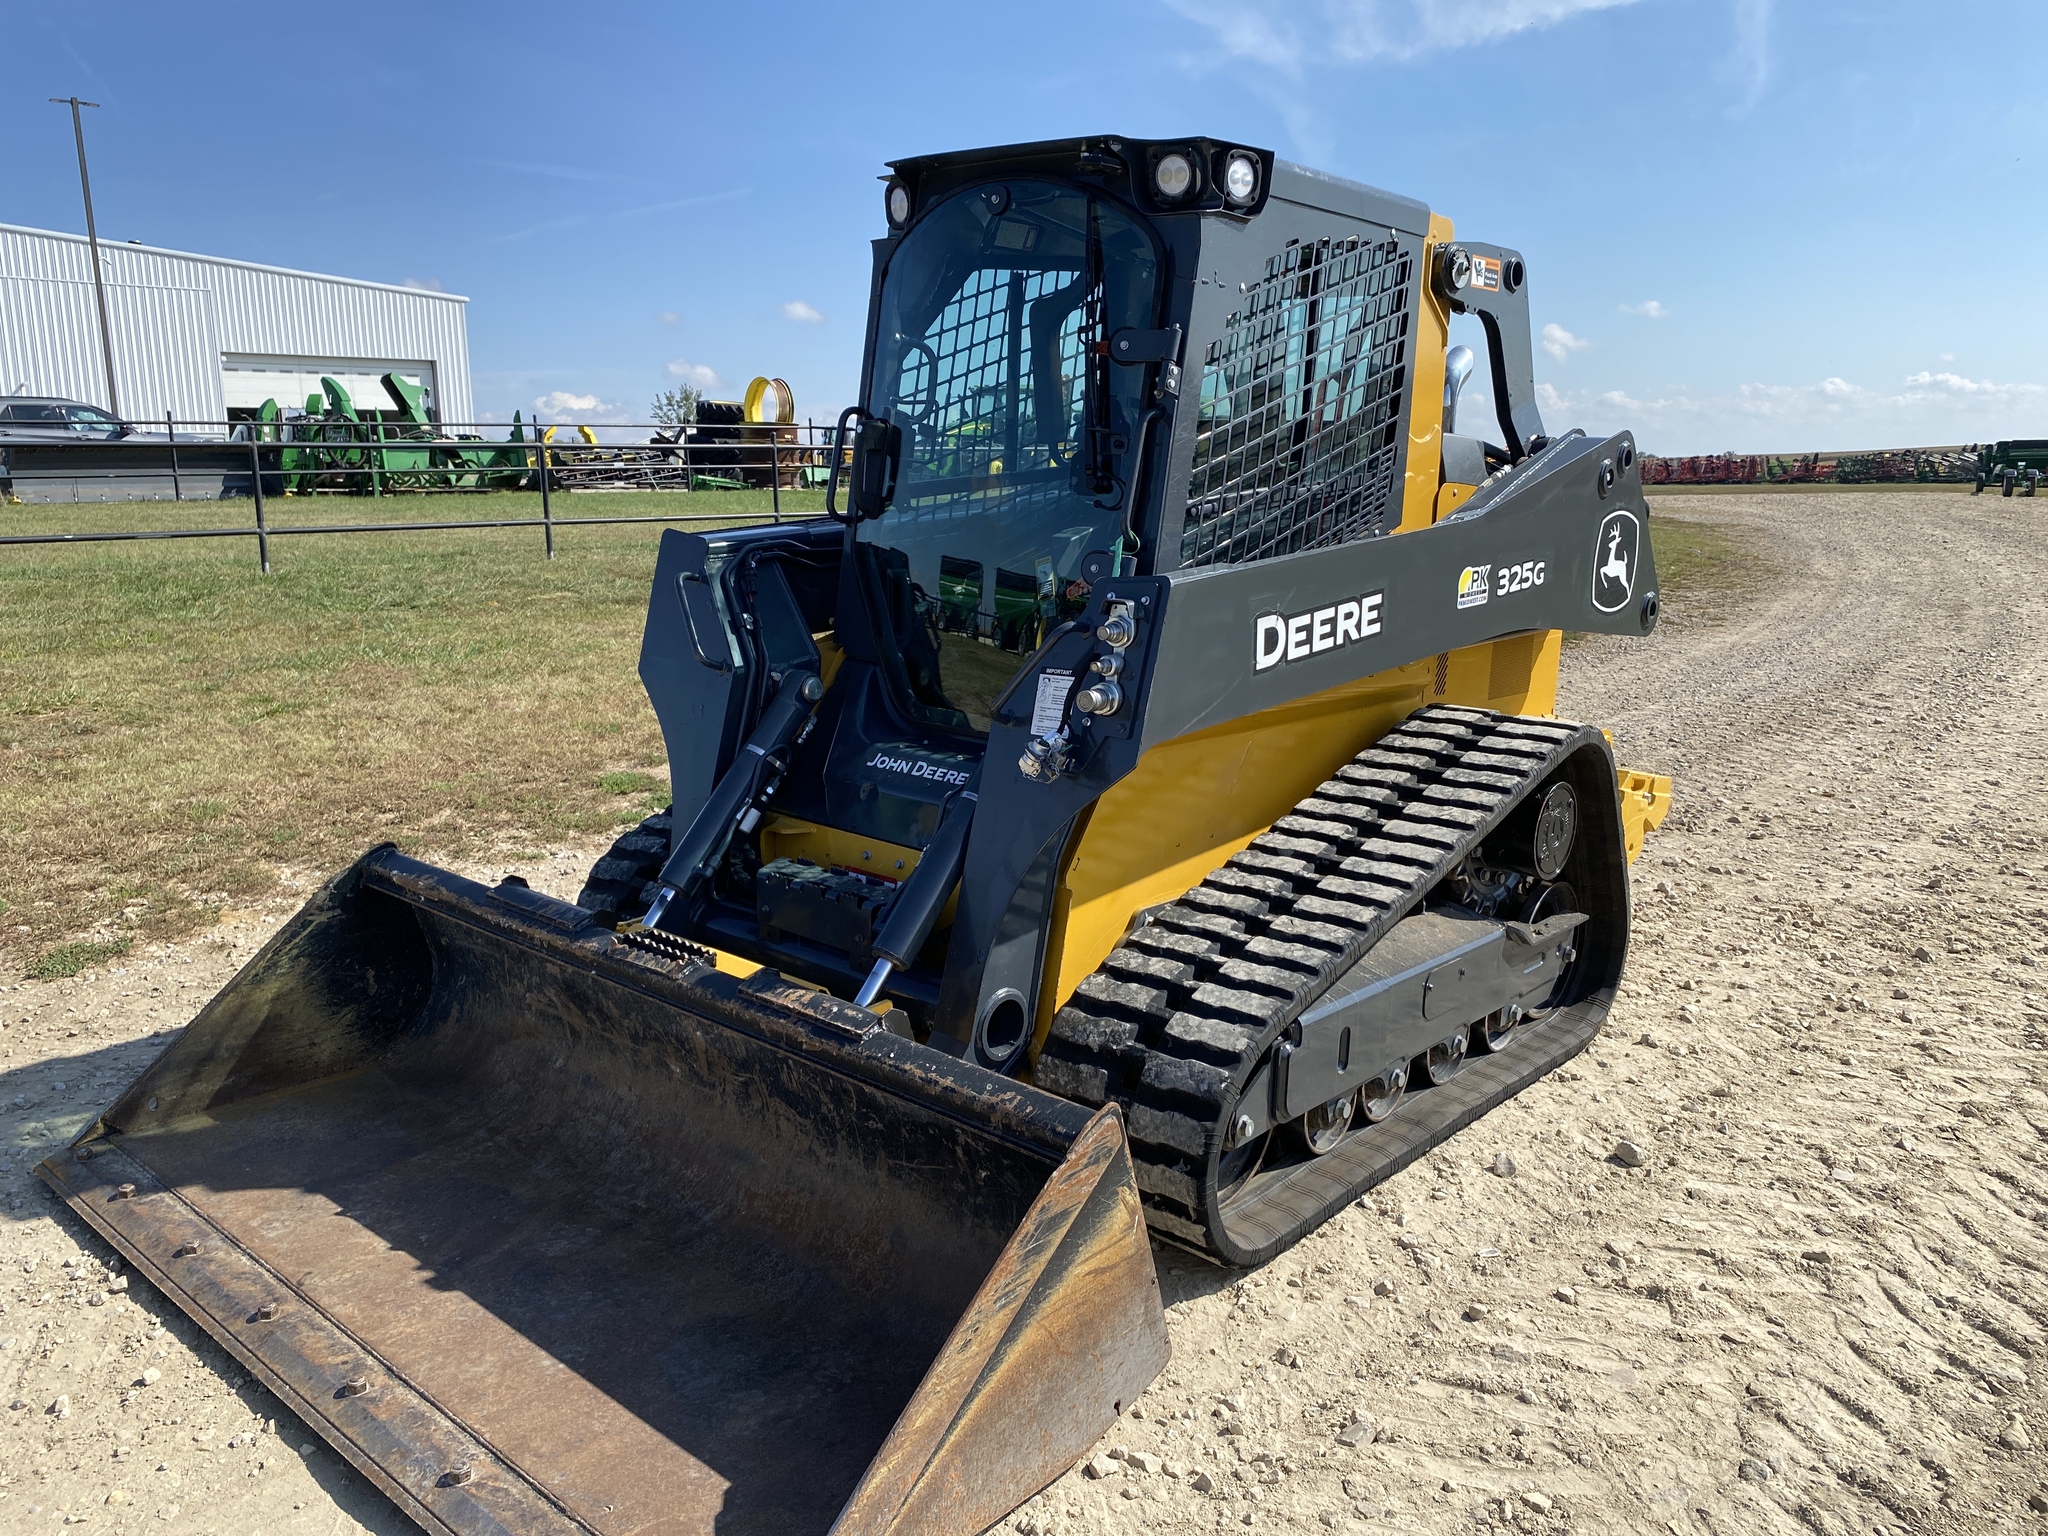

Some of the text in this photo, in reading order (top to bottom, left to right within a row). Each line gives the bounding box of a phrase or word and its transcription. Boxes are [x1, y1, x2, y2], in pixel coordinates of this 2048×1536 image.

[1496, 561, 1545, 596] 325G
[1256, 592, 1383, 671] DEERE
[1045, 668, 1073, 676] IMPORTANT
[866, 752, 970, 786] JOHN DEERE
